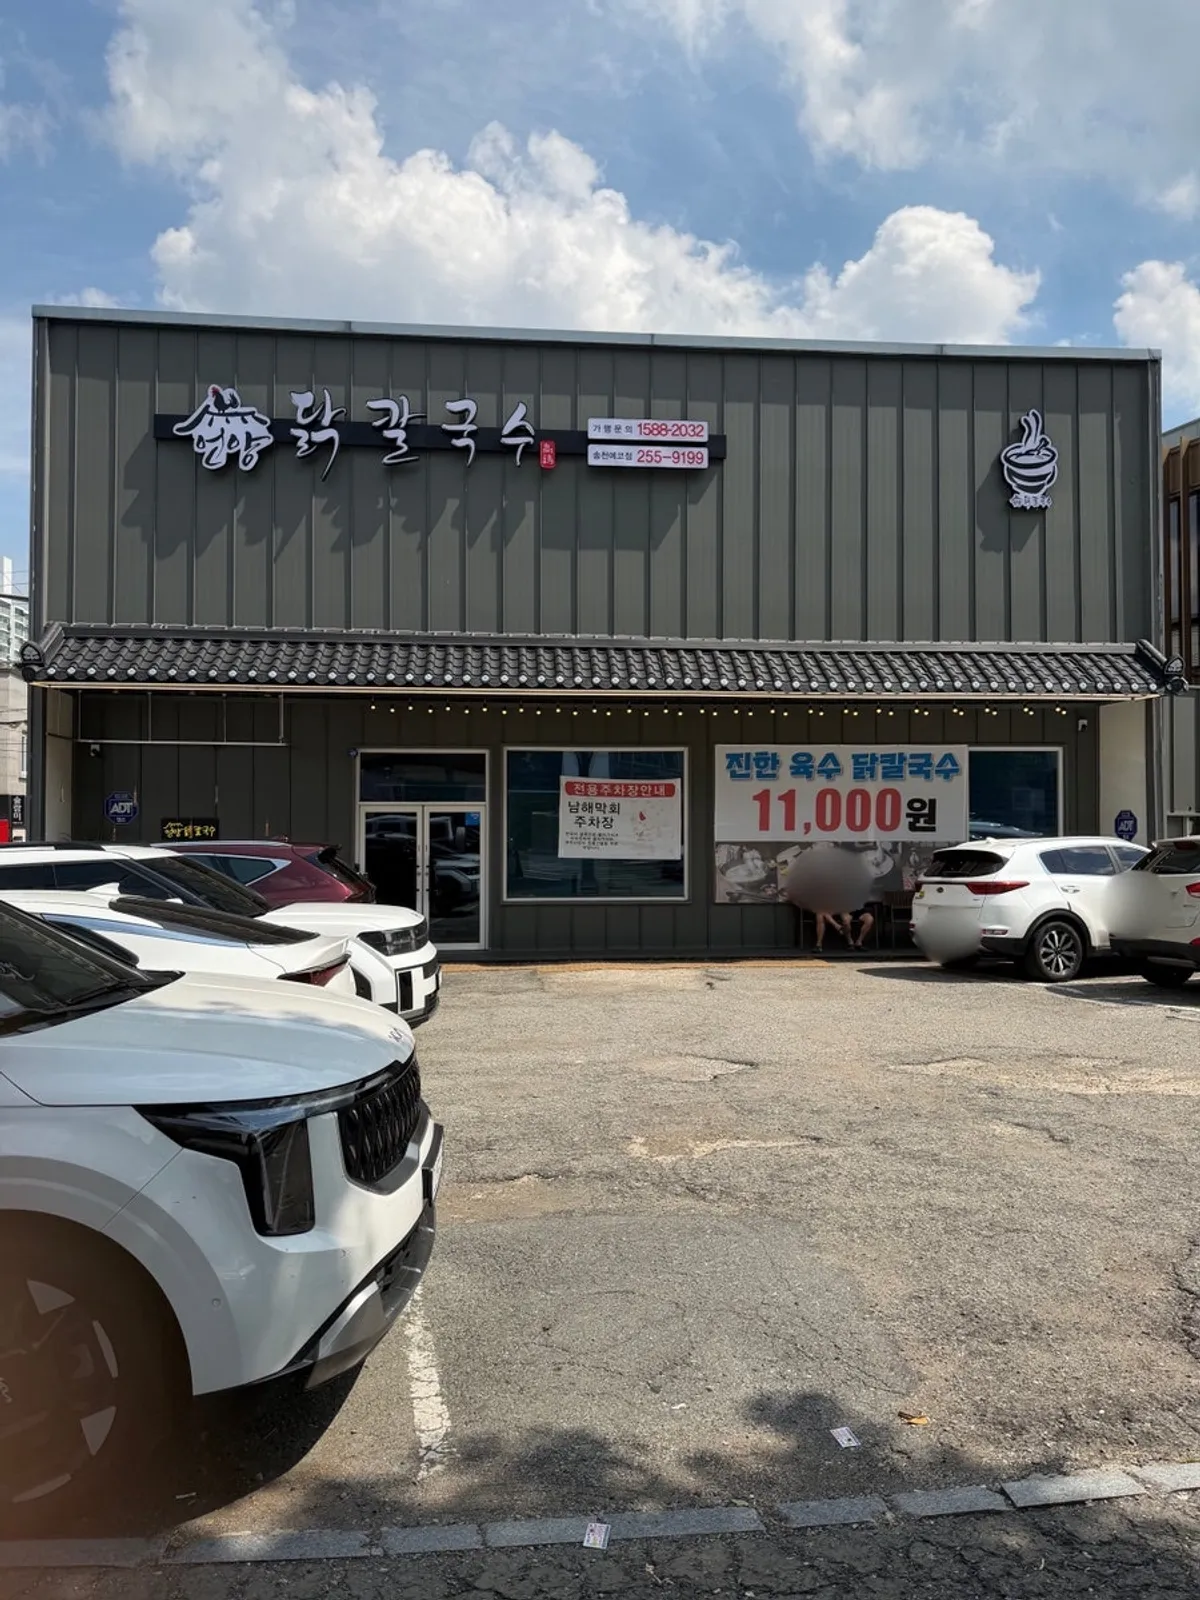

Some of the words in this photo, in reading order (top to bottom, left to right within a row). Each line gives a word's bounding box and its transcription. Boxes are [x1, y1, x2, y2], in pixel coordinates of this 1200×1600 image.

[289, 388, 536, 480] 닭칼국수
[637, 422, 704, 438] 1588-2032
[637, 449, 704, 465] 255-9199
[725, 751, 780, 780] 진한
[789, 751, 842, 781] 육수
[851, 752, 961, 782] 닭칼국수
[110, 802, 133, 814] ADT
[568, 801, 621, 815] 남해막회
[574, 815, 614, 829] 주차장
[1118, 820, 1135, 832] ADT
